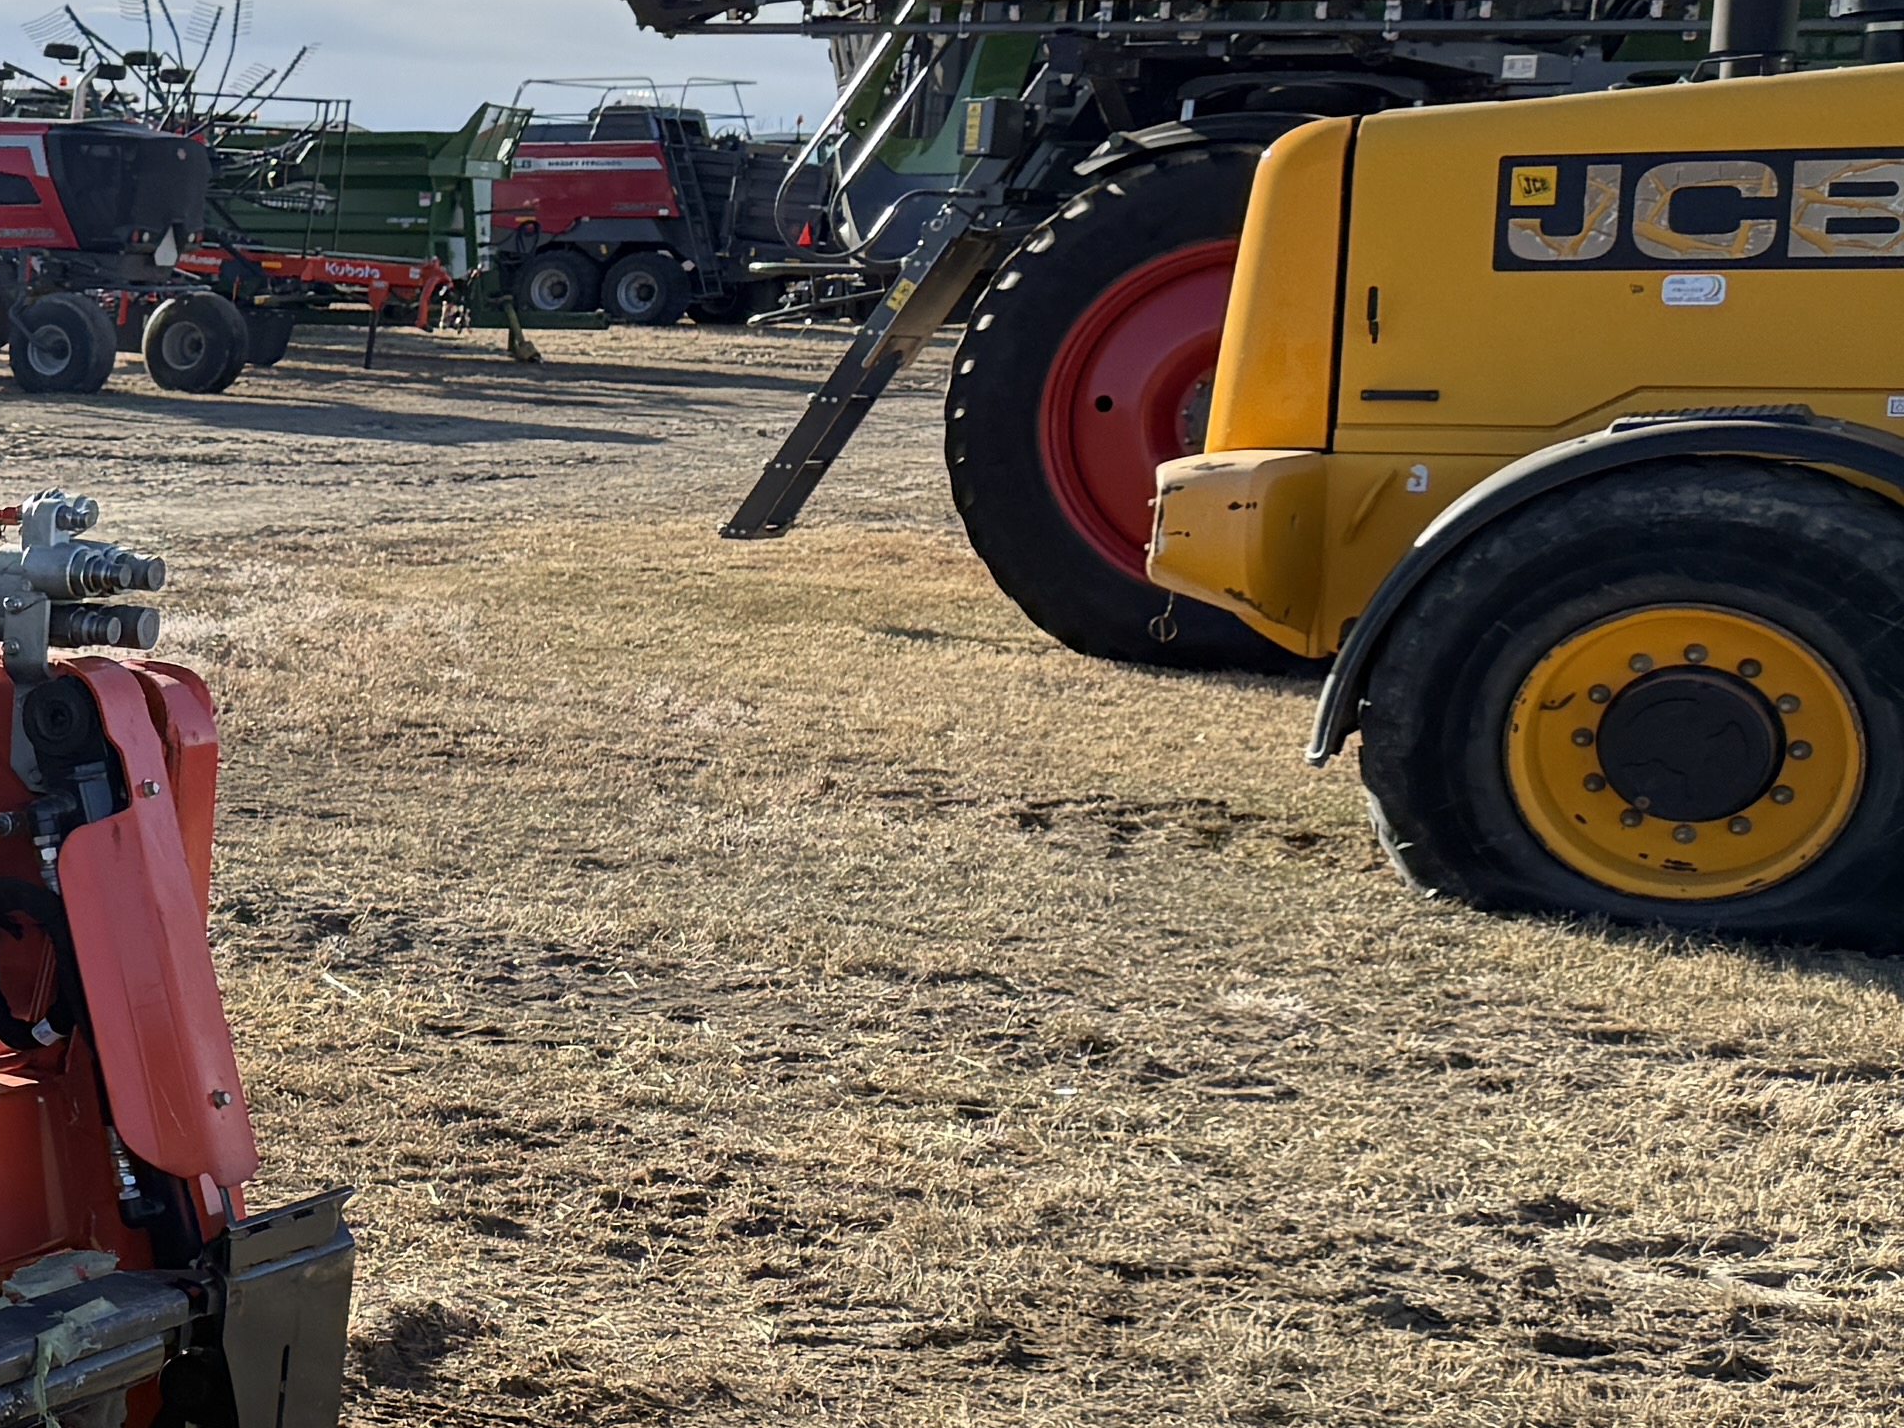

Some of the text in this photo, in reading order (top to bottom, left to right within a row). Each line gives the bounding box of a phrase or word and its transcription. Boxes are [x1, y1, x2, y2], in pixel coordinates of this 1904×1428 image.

[1522, 175, 1551, 196] JCB
[1507, 158, 1904, 261] JCB
[324, 261, 382, 279] Kubota
